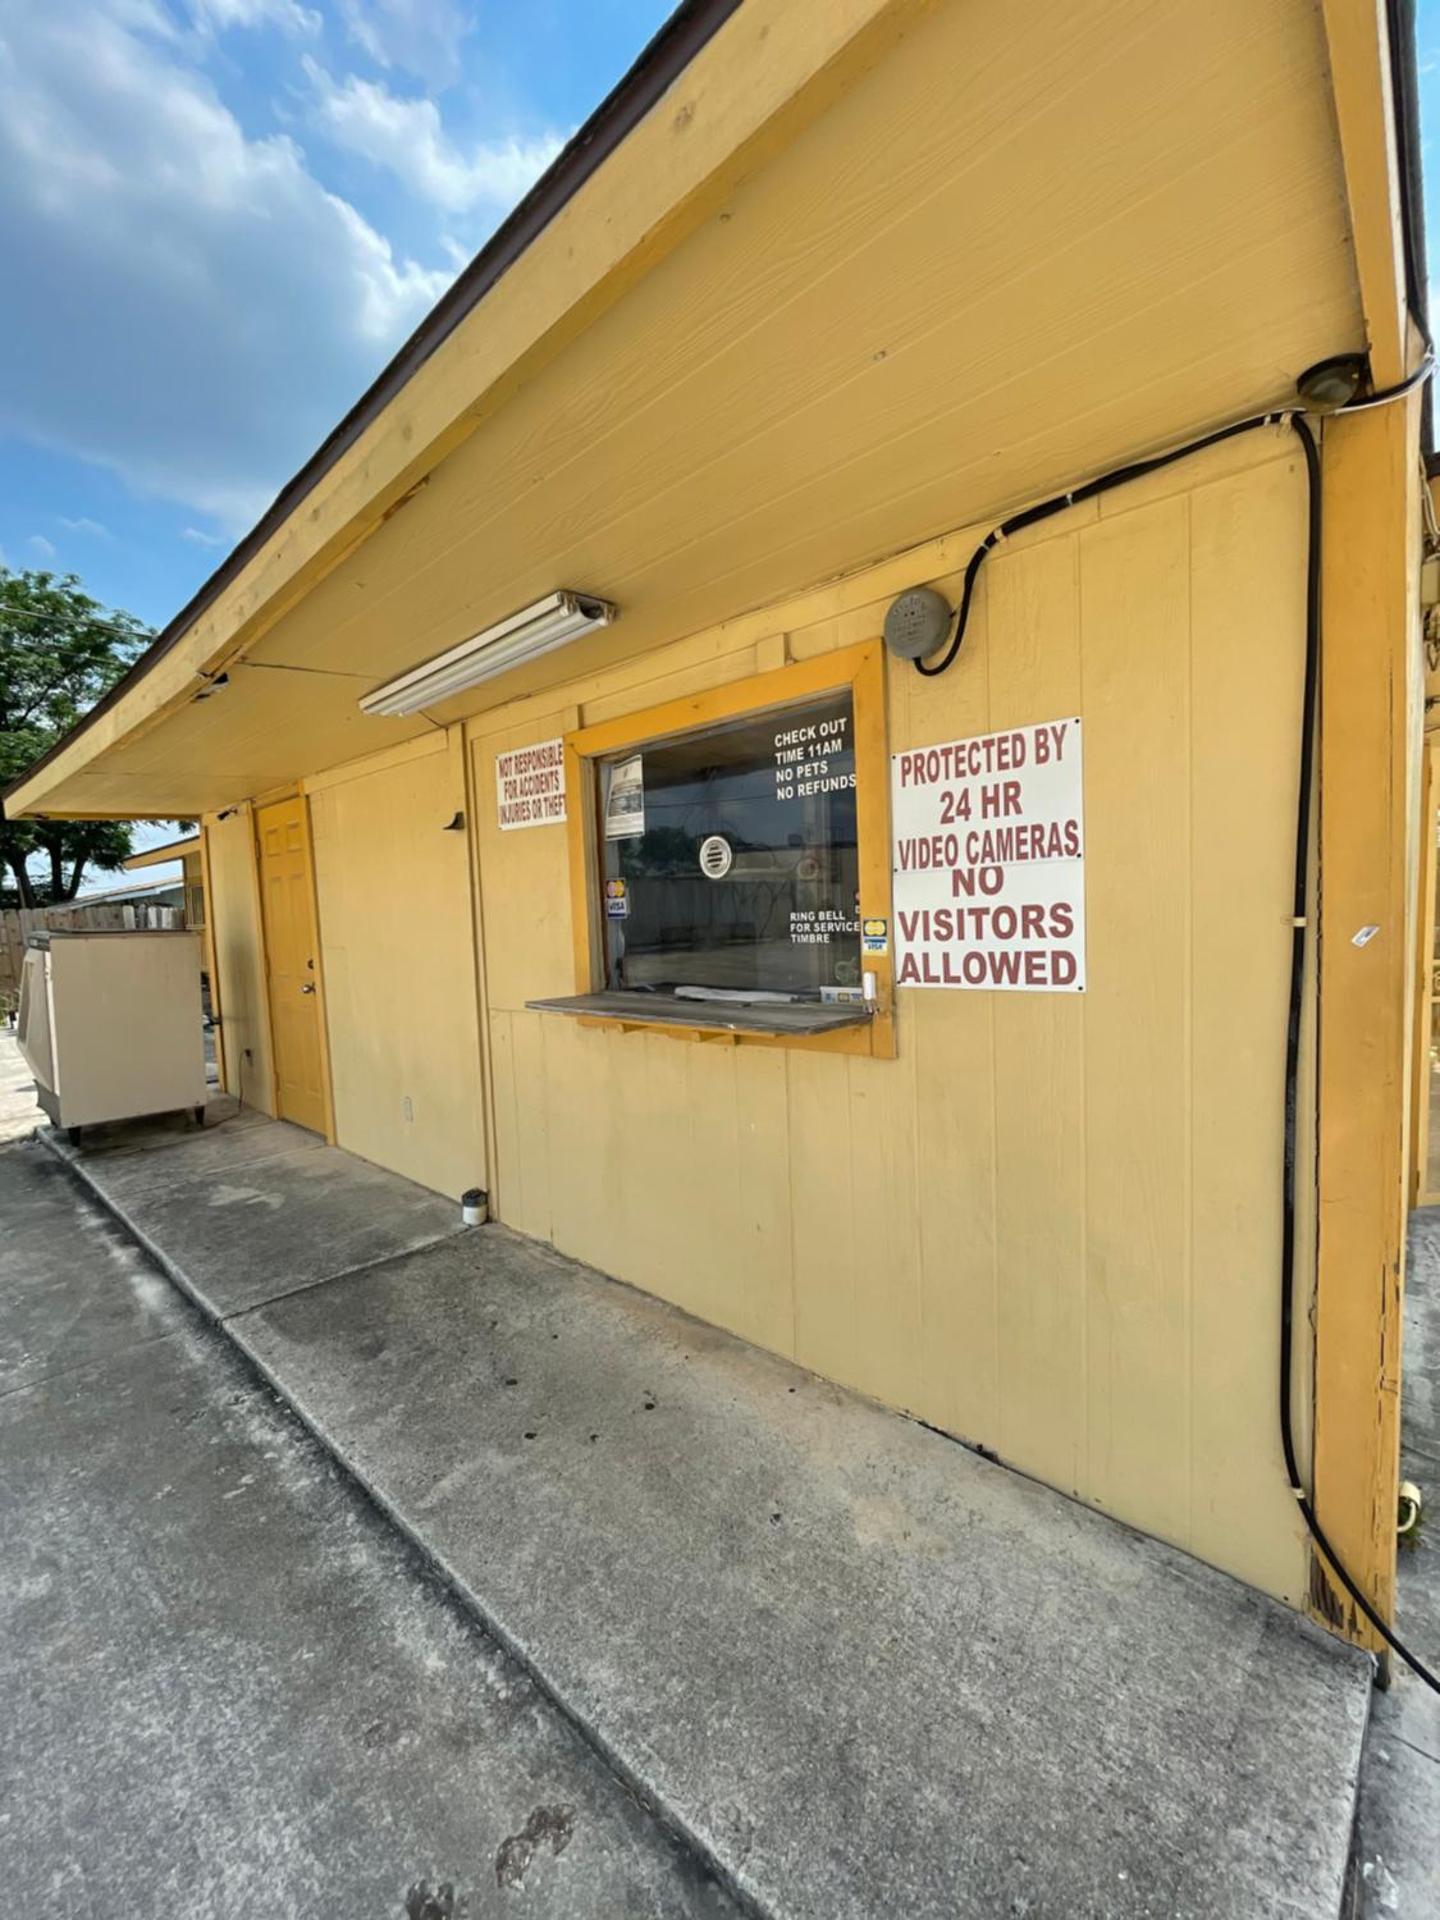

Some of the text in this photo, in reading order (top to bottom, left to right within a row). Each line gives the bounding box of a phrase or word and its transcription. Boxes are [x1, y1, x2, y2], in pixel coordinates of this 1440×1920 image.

[775, 717, 847, 747] CHECK OUT
[499, 743, 563, 778] NOT RESPONSIBLE
[775, 738, 842, 765] TIME 11AM
[901, 723, 1068, 788] PROTECTED BY
[504, 770, 560, 801] FOR ACCIDENTS
[776, 760, 828, 783] NO PETS
[777, 773, 857, 801] NO REFUNDS
[940, 780, 1023, 824] 24 HR
[500, 800, 531, 825] INJURIES
[532, 798, 543, 819] OR
[898, 819, 1079, 870] VIDEO CAMERAS
[952, 865, 1004, 897] NO
[790, 910, 846, 922] RING BELL
[790, 921, 860, 932] FOR SERVICE
[898, 902, 1074, 942] VISITORS
[791, 933, 830, 943] TIMBRE
[900, 950, 1077, 986] ALLOWED
